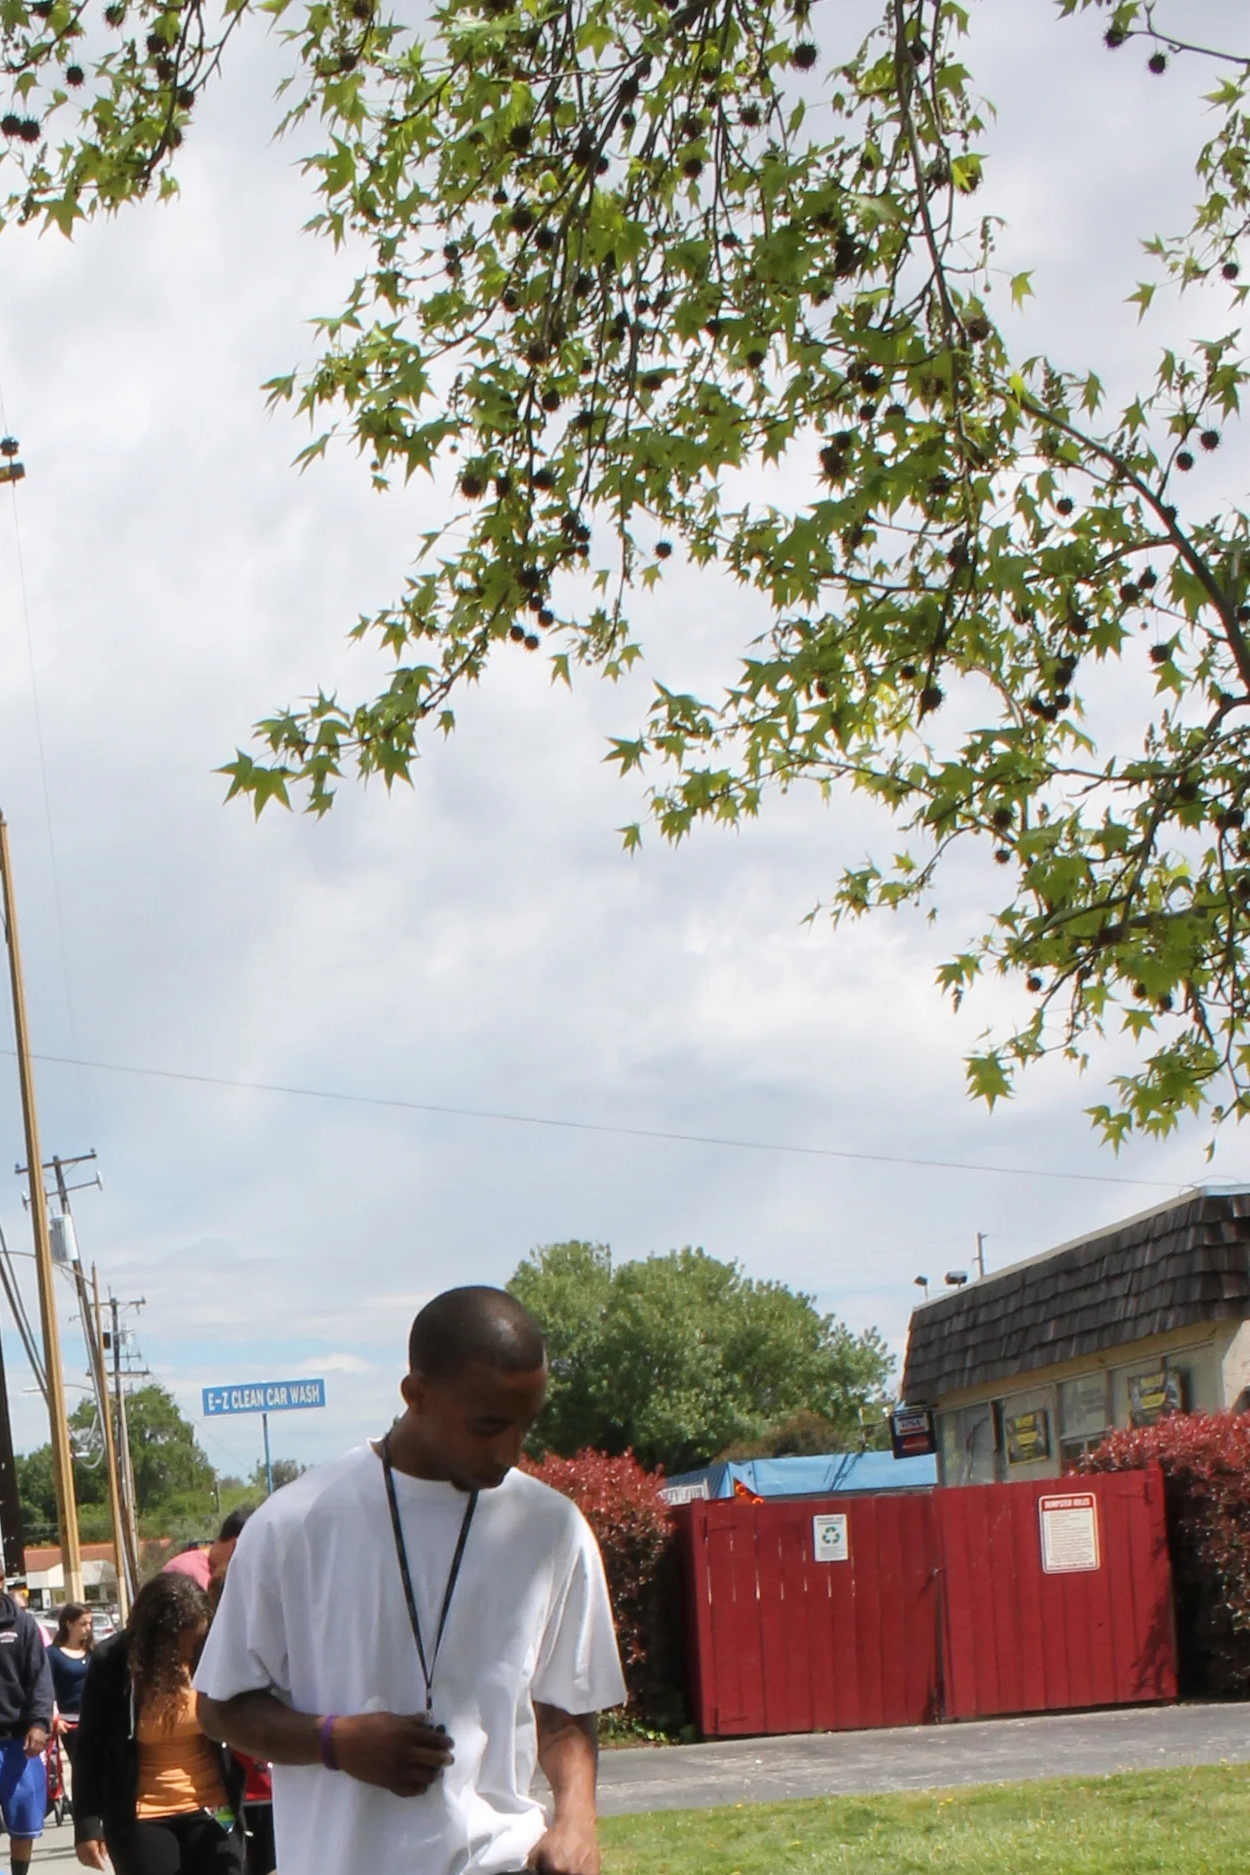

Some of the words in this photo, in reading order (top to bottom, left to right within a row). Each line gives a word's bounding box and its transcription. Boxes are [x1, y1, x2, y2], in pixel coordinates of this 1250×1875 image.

[207, 1391, 230, 1411] E-Z
[231, 1388, 265, 1409] CLEAN
[266, 1386, 288, 1406] CAR
[290, 1383, 320, 1405] WASH
